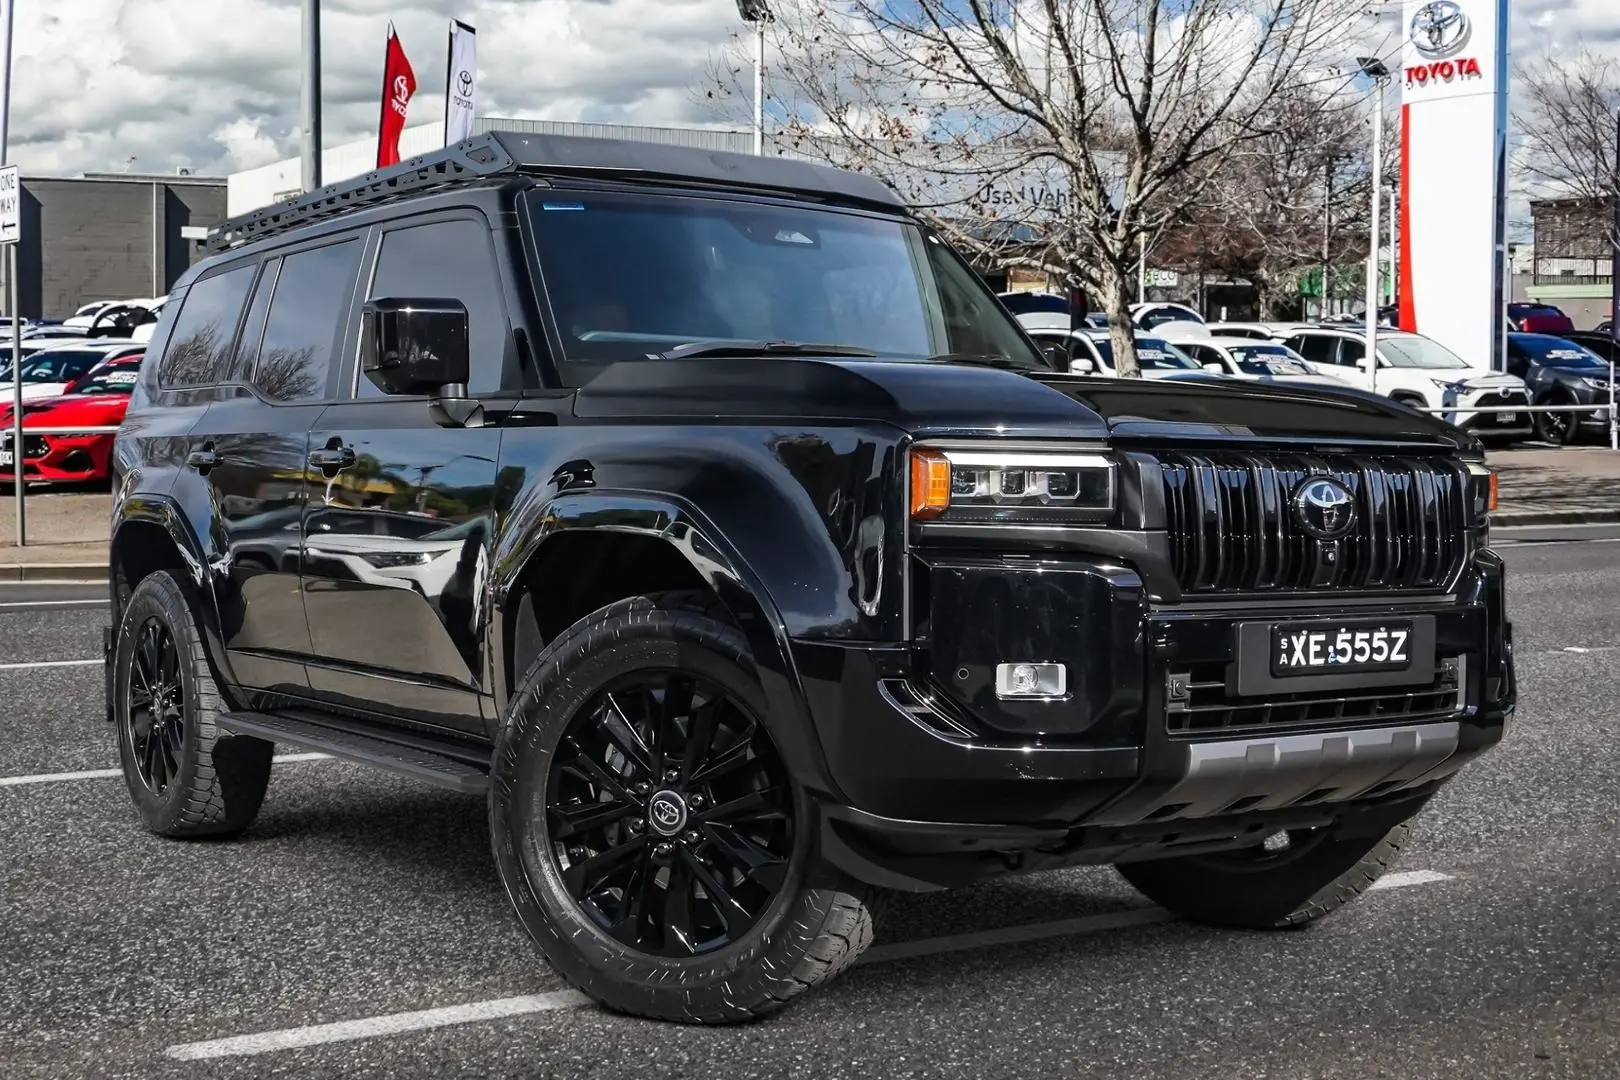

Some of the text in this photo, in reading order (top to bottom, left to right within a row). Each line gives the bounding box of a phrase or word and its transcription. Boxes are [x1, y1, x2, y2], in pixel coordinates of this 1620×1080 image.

[1404, 58, 1481, 83] TOYOTA
[1, 173, 15, 191] ONE
[978, 183, 1025, 204] Used
[0, 196, 16, 213] WAY
